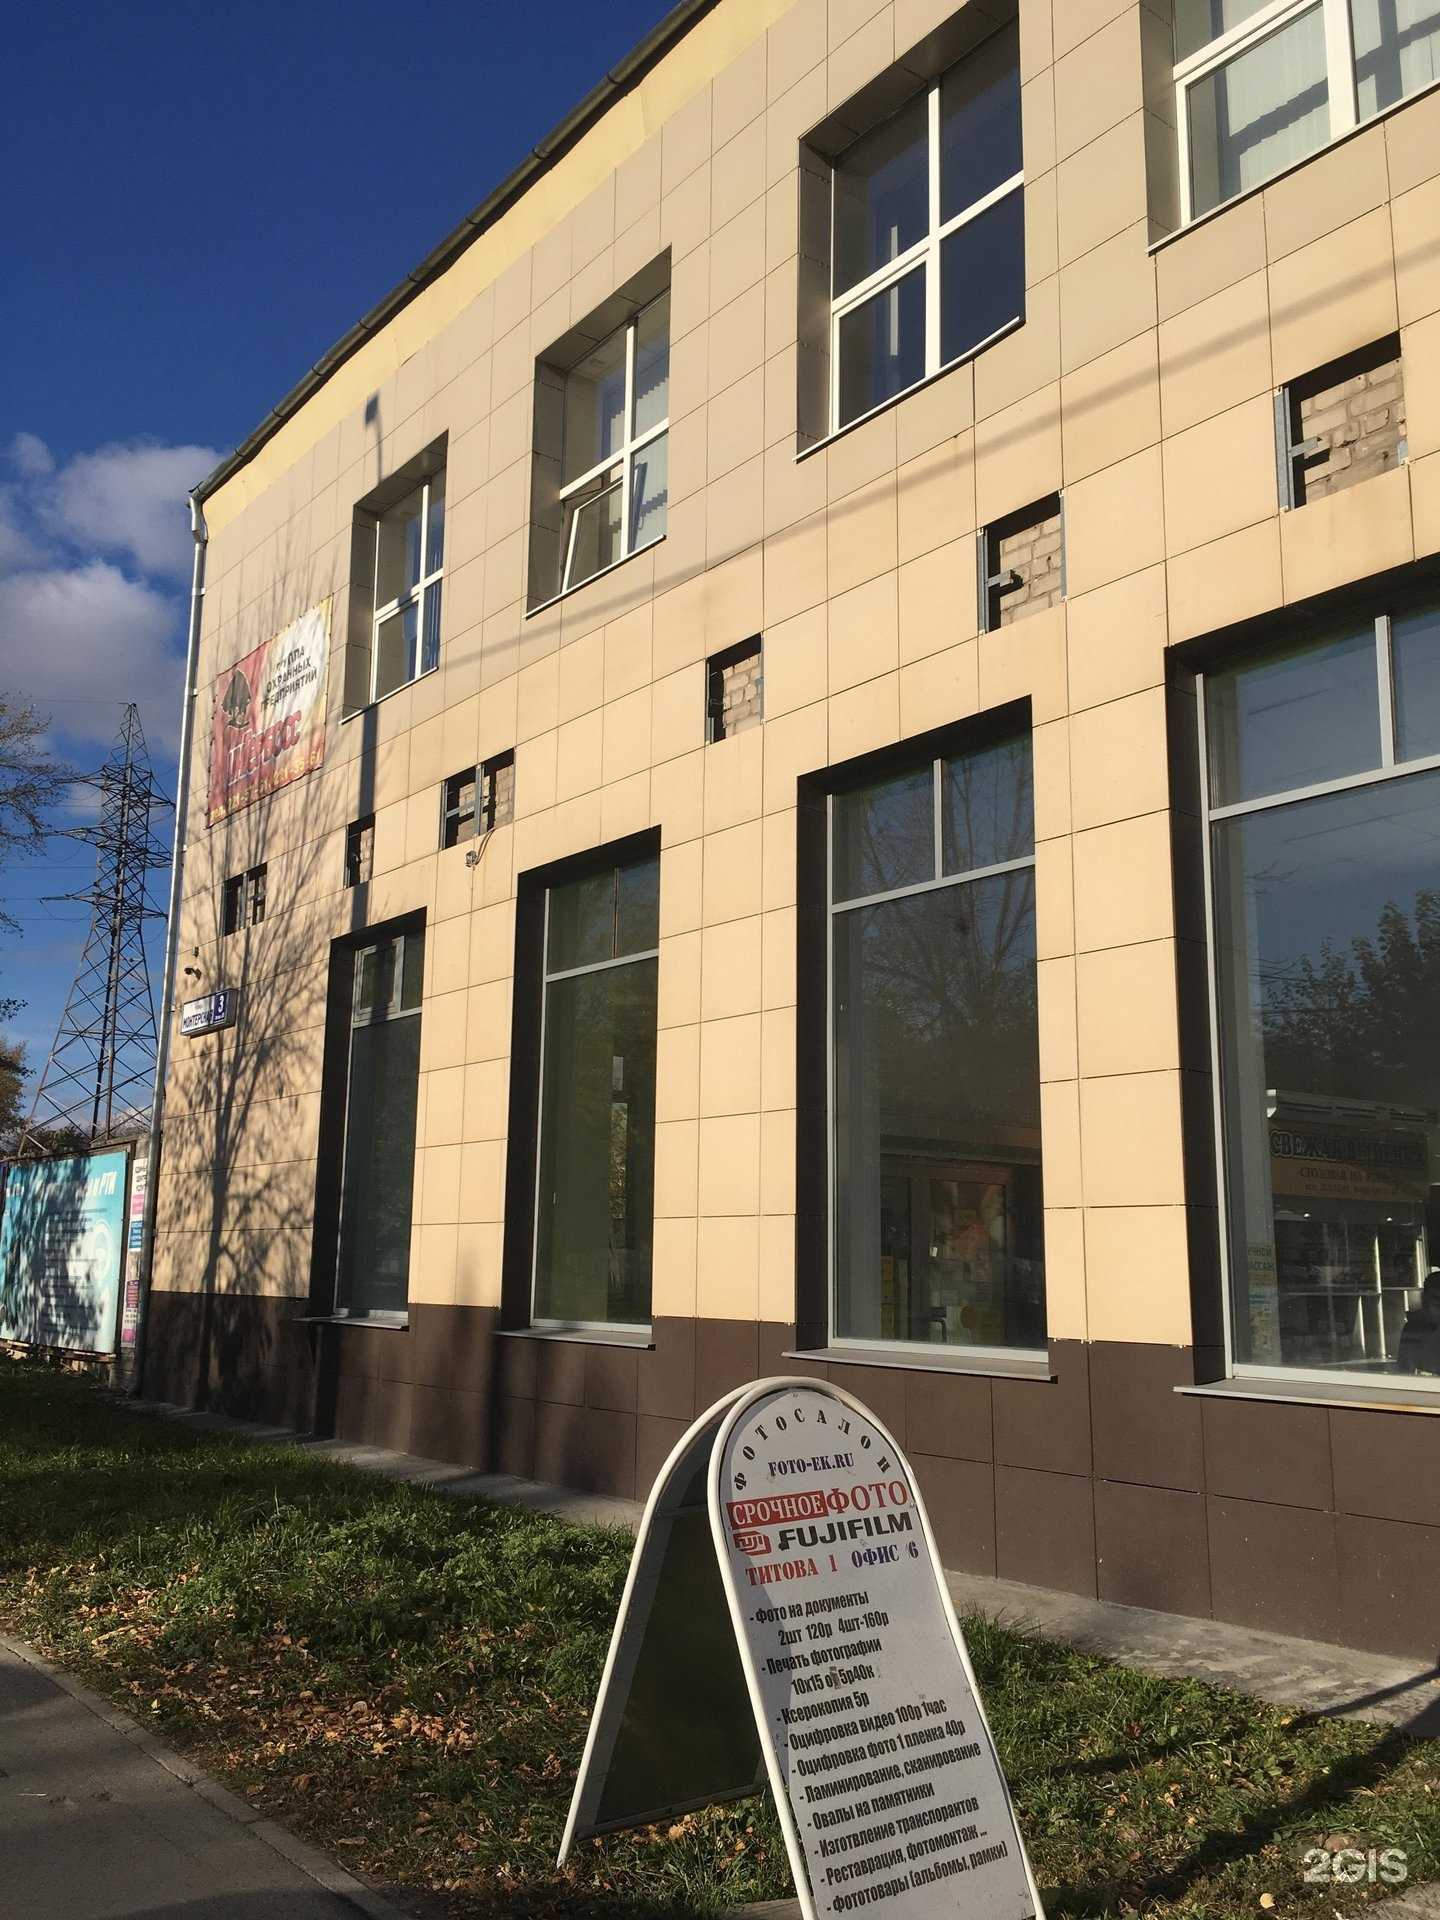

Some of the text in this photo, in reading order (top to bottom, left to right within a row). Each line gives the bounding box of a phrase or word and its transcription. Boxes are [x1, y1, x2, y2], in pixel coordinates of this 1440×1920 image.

[261, 667, 318, 712] ПРЕДПРИЯТИЙ
[266, 656, 311, 693] ОХРАННЫХ
[768, 1453, 854, 1477] FOTO-EK.RU
[732, 1481, 908, 1525] СРОЧНОЕ ФОТО
[778, 1512, 913, 1551] FUJIFILM
[745, 1558, 819, 1586] ТИТОВА
[828, 1554, 838, 1573] 1
[851, 1544, 899, 1569] ОФИС
[788, 1604, 804, 1619] на
[805, 1592, 870, 1618] документы
[778, 1611, 890, 1646] 2шт 120р 4шт-160р
[766, 1638, 883, 1676] Печать фотографии
[791, 1674, 824, 1696] 10х15
[838, 1664, 875, 1689] 5р40к
[781, 1691, 870, 1725] Ксерокопия 5р
[789, 1699, 947, 1751] Оцифровка видео 100р 1час
[796, 1719, 966, 1777] Оцифровка фото 1 пленка 40р
[804, 1742, 982, 1803] Ламинирование, сканирование
[812, 1781, 935, 1830] Овалы на памятники
[819, 1797, 980, 1858] Изготвление транспорантов
[826, 1848, 907, 1886] Реставрация,
[906, 1825, 979, 1861] фотомонтаж
